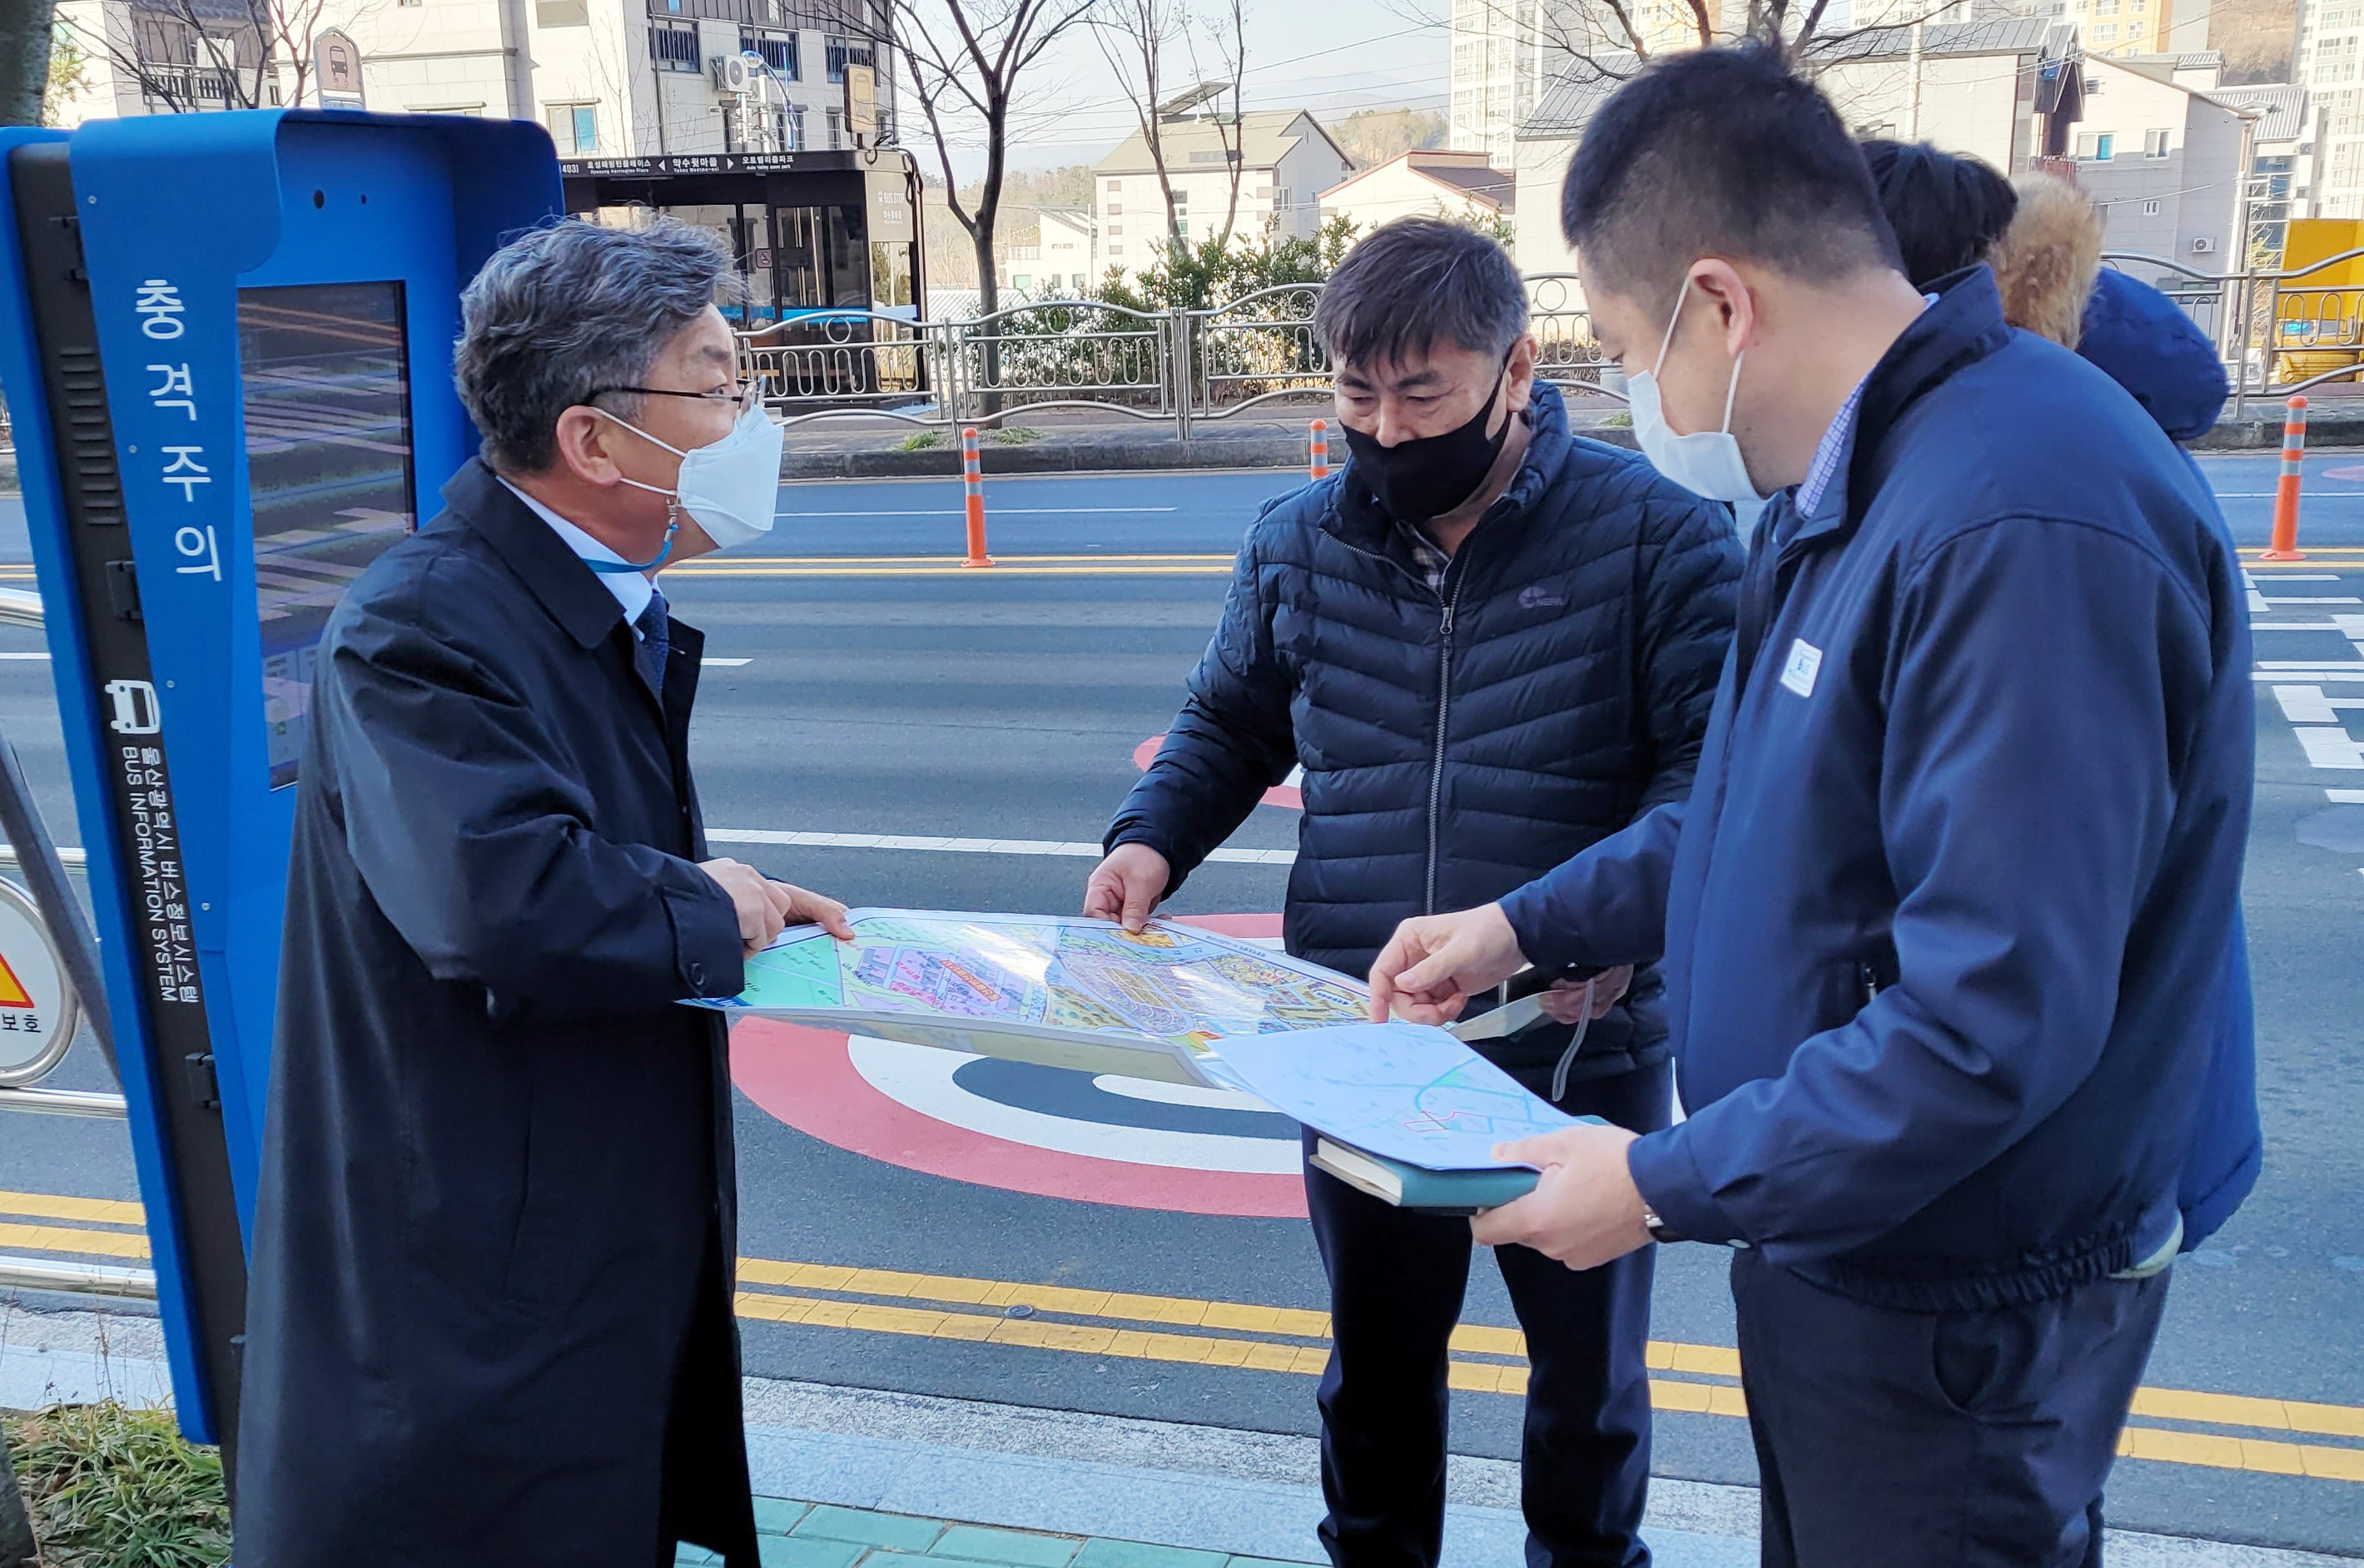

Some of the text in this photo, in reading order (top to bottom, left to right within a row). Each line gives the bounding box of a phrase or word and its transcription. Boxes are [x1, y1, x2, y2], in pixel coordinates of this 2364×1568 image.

[672, 156, 718, 169] 약수윗마을
[883, 191, 905, 204] BUS STOP
[135, 279, 222, 583] 충격주의
[122, 746, 178, 1002] BUS INFORMATION SYSTEM
[141, 746, 200, 1004] 울산광역시 버스정보시스템
[2, 1013, 42, 1034] 보호
